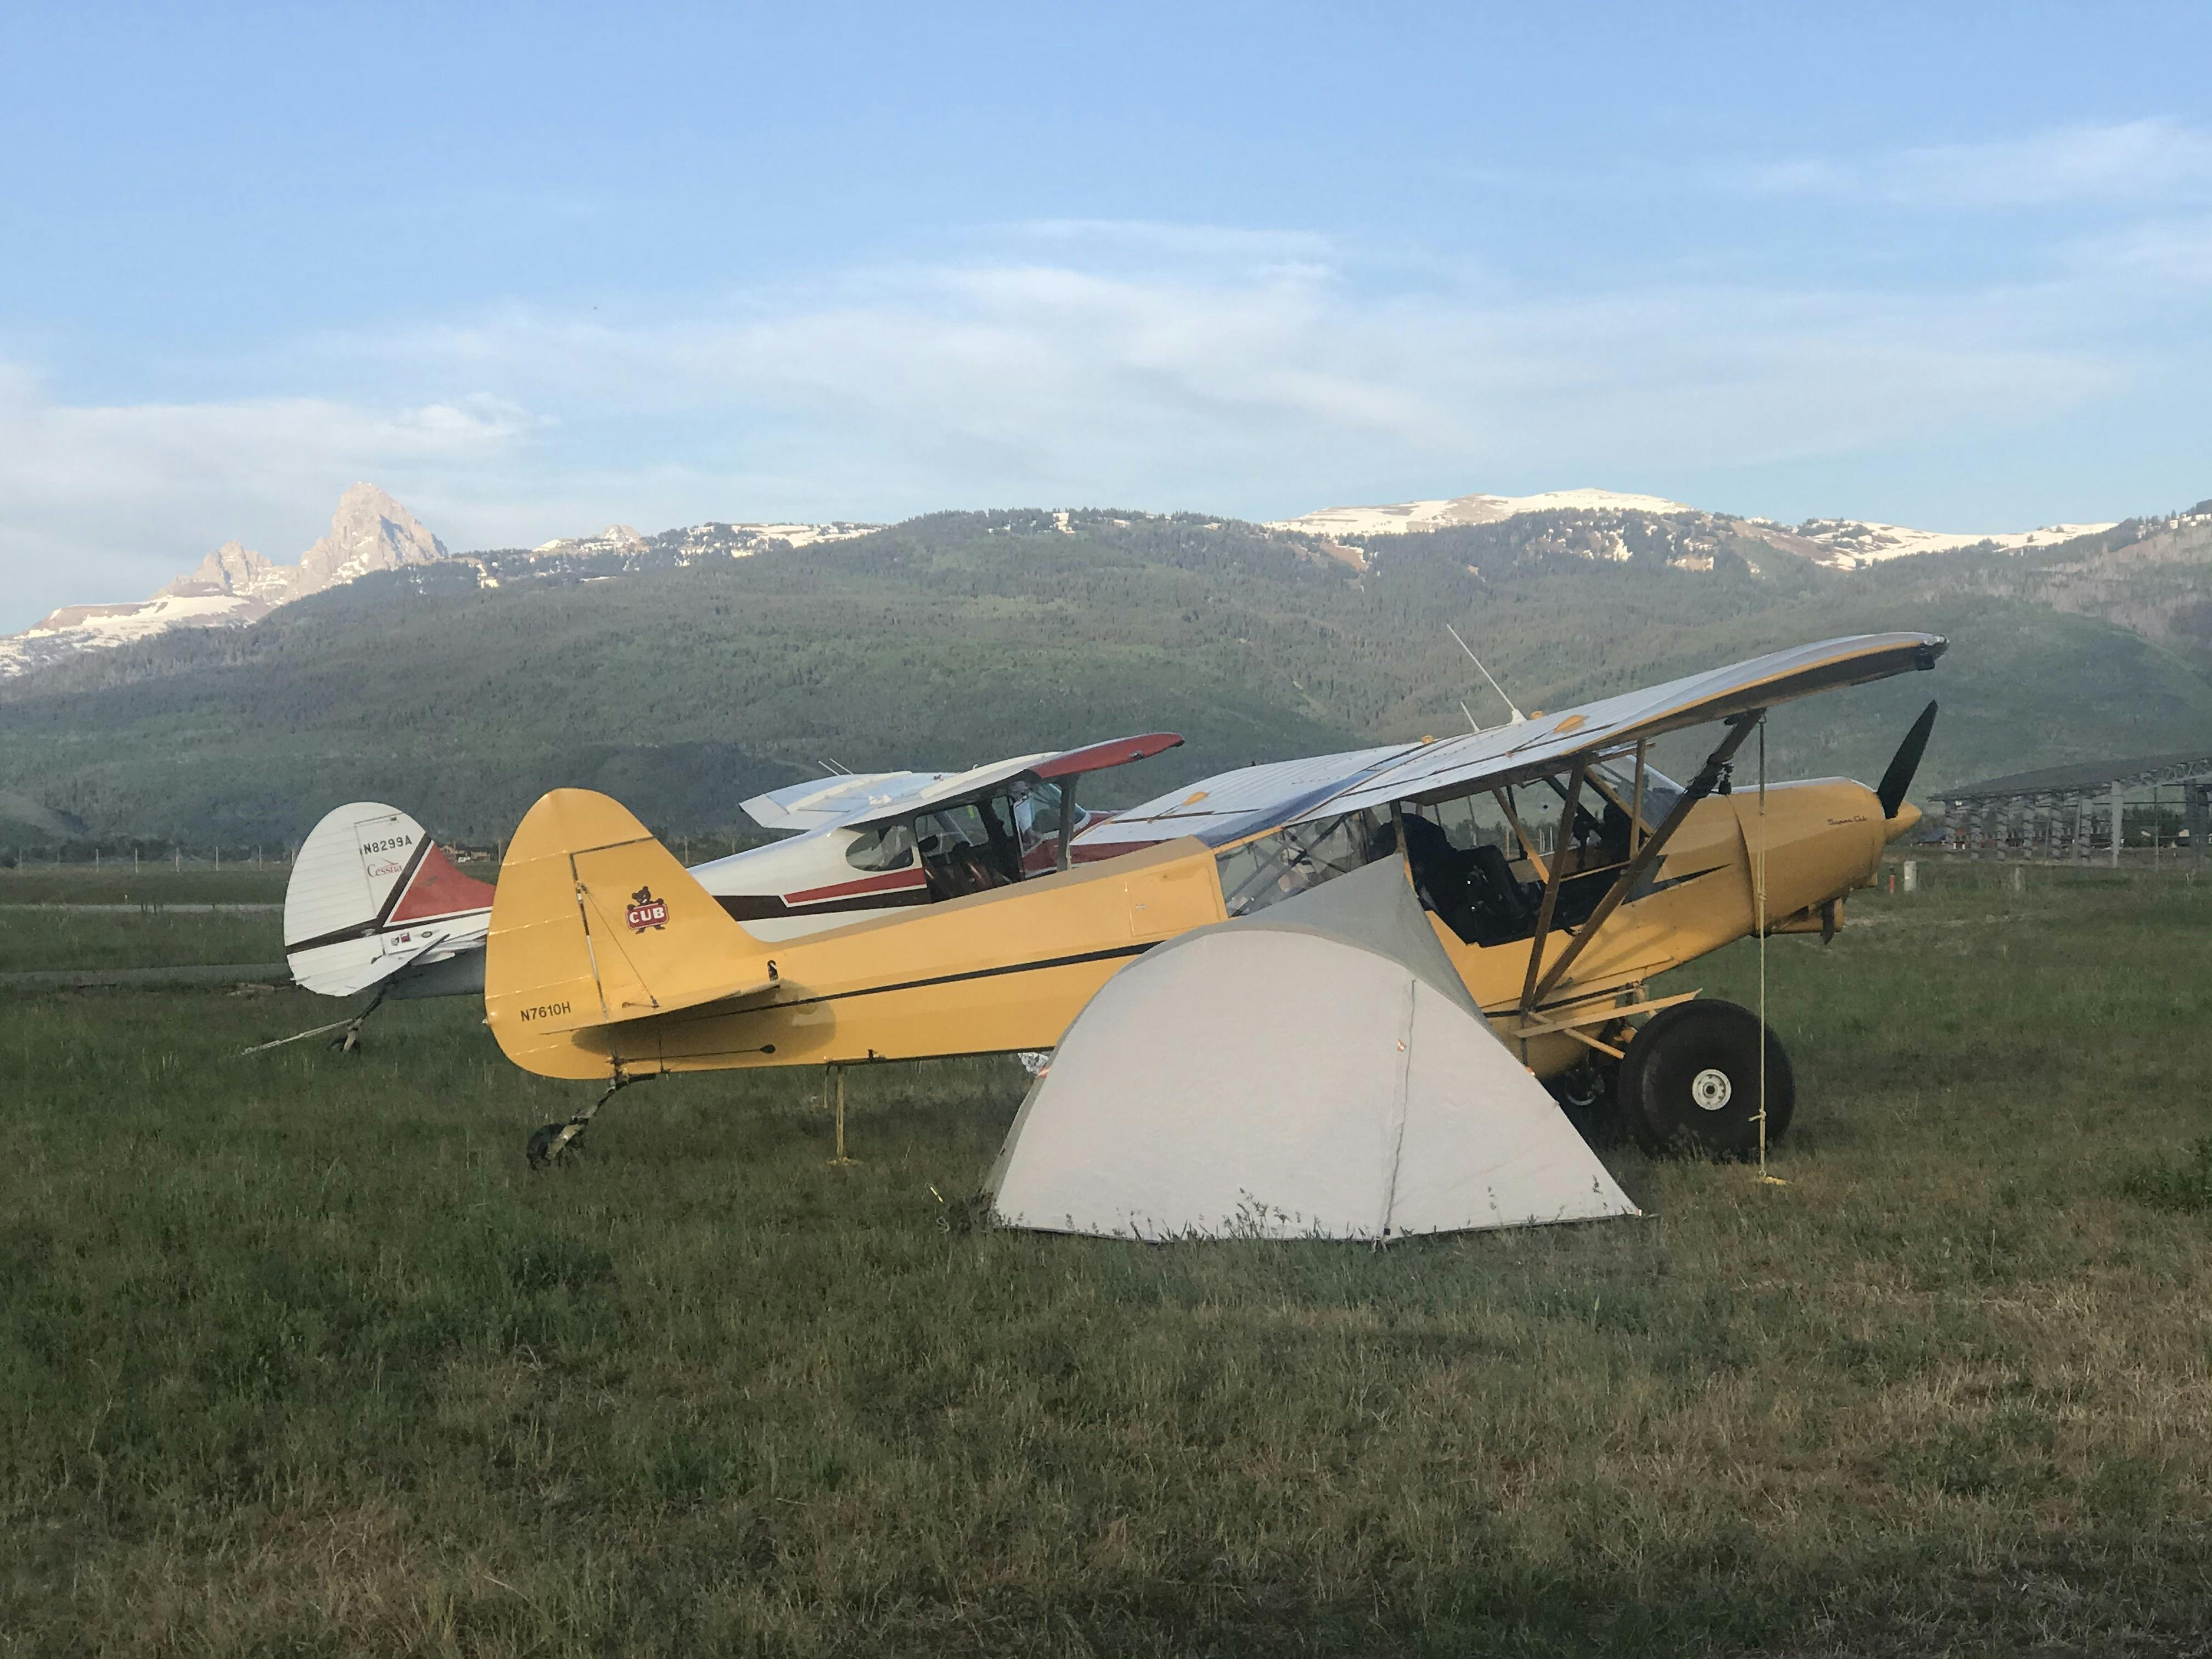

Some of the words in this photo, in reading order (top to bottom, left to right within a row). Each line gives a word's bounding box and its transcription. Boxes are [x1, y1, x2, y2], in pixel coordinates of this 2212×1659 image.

[363, 835, 412, 854] N8299A
[629, 907, 665, 923] CUB
[521, 1001, 571, 1022] N7610H
